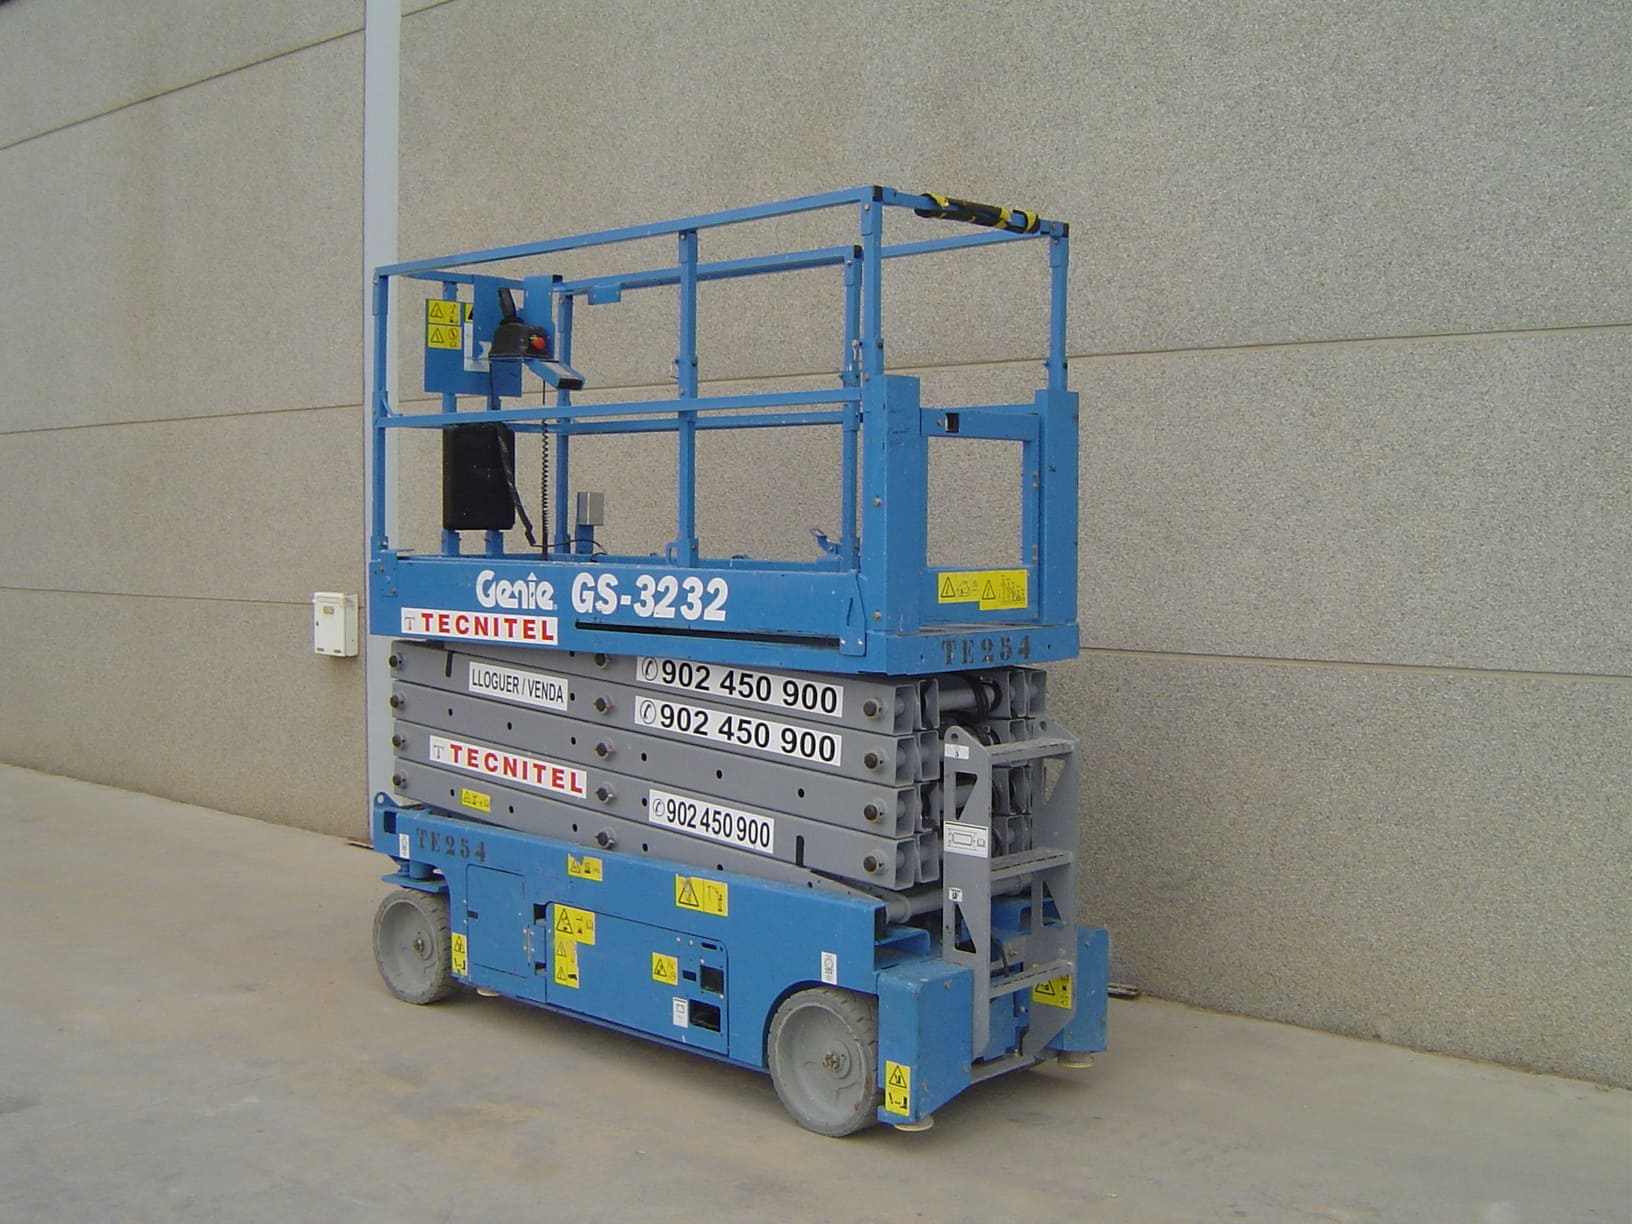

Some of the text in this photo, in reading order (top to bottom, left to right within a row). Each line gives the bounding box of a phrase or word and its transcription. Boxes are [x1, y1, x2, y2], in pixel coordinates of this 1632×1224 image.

[476, 569, 729, 622] Genie GS-3232
[421, 613, 554, 641] TECNITEL
[661, 659, 838, 714] 902 450 900
[660, 703, 836, 762] 902 450 900
[450, 743, 583, 794] TECNITEL
[666, 798, 770, 848] 902 450 900
